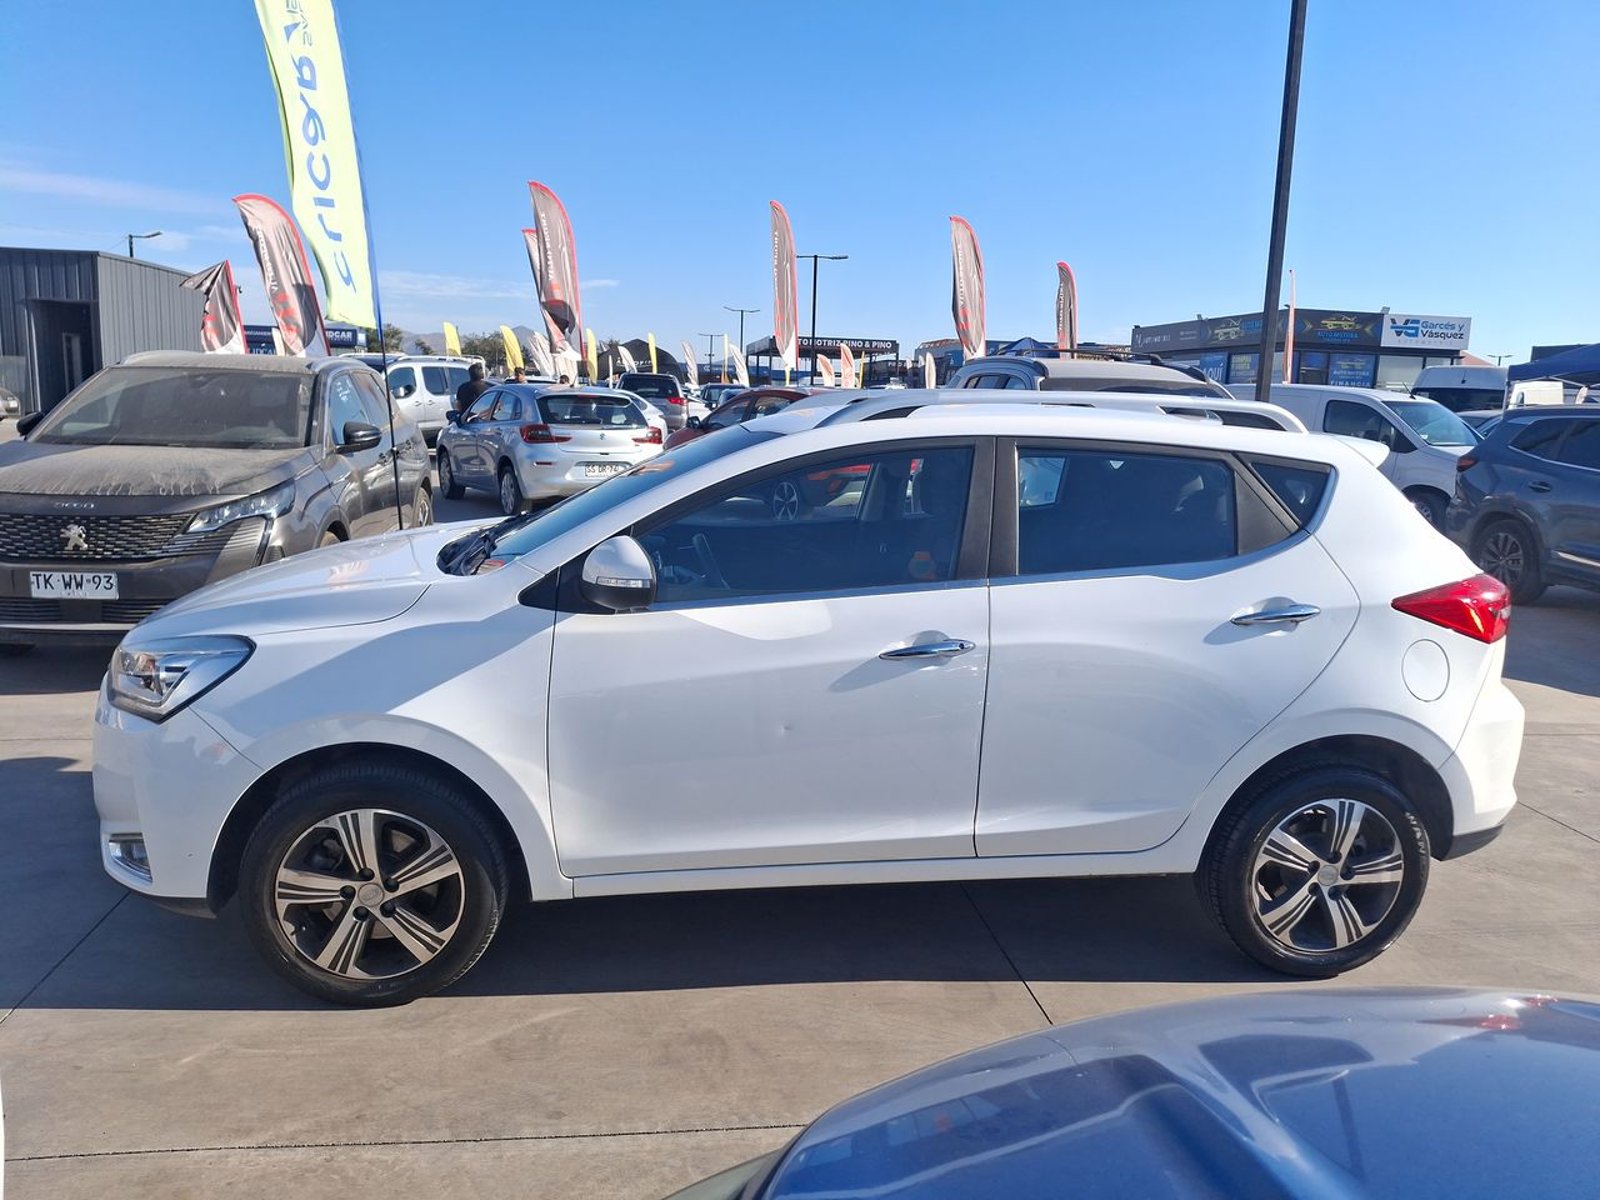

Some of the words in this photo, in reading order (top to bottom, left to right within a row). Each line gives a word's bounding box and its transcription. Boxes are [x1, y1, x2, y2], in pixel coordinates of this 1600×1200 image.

[1421, 320, 1456, 331] Garcés
[1458, 323, 1465, 332] y
[1420, 329, 1465, 341] Vásquez
[864, 340, 870, 348] &
[872, 341, 892, 349] PINO
[32, 573, 55, 590] TK
[61, 574, 84, 590] WW
[91, 575, 114, 591] 93
